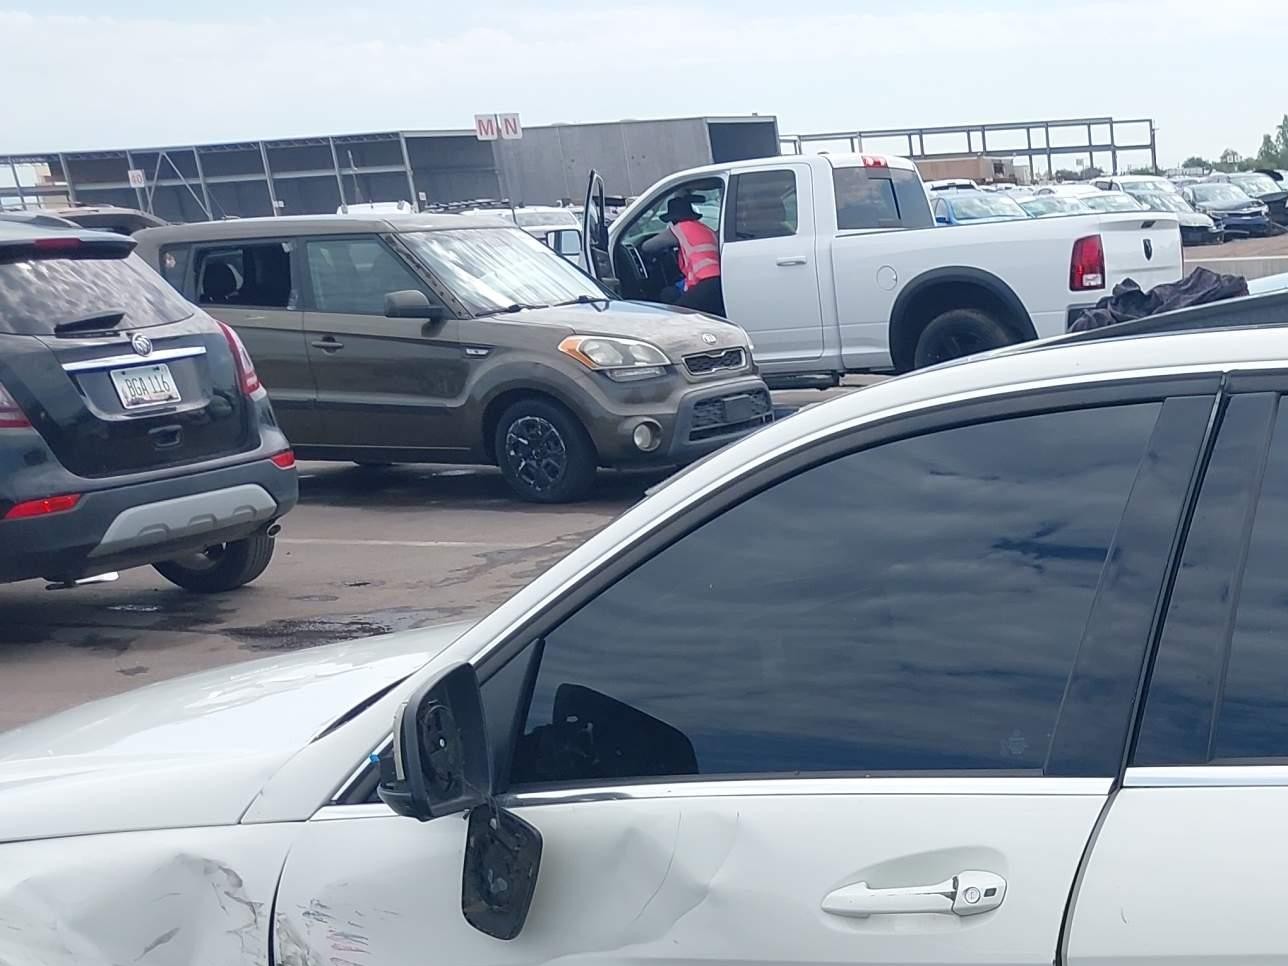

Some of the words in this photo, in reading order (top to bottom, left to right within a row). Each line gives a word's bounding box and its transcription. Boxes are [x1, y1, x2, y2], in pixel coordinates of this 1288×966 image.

[478, 119, 495, 136] M
[503, 118, 518, 135] N
[125, 377, 150, 398] BGA
[148, 374, 170, 394] 116
